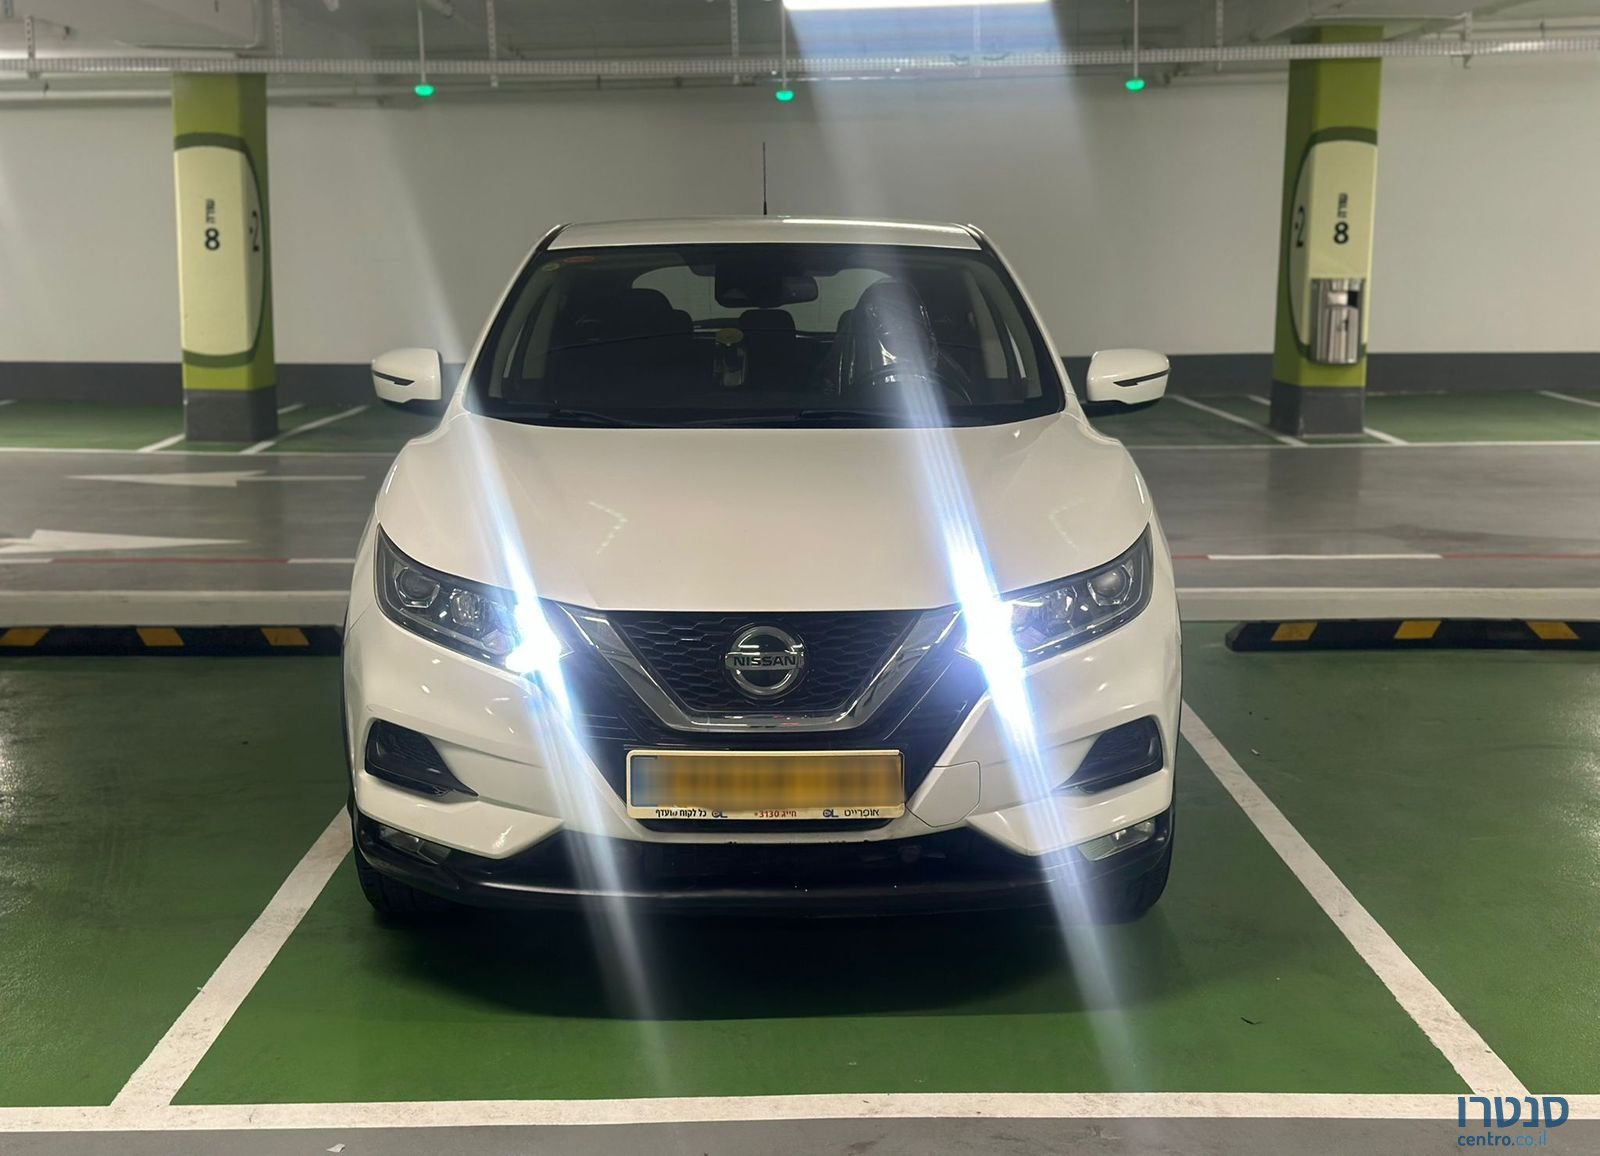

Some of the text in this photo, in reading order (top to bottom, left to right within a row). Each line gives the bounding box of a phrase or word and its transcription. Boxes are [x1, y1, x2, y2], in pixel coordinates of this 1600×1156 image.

[1333, 221, 1349, 245] 8
[205, 228, 220, 251] 8
[733, 656, 796, 666] NISSAN
[679, 808, 697, 818] לקוח
[698, 808, 707, 817] כל
[781, 810, 797, 818] חייג
[844, 808, 880, 817] אופרייט
